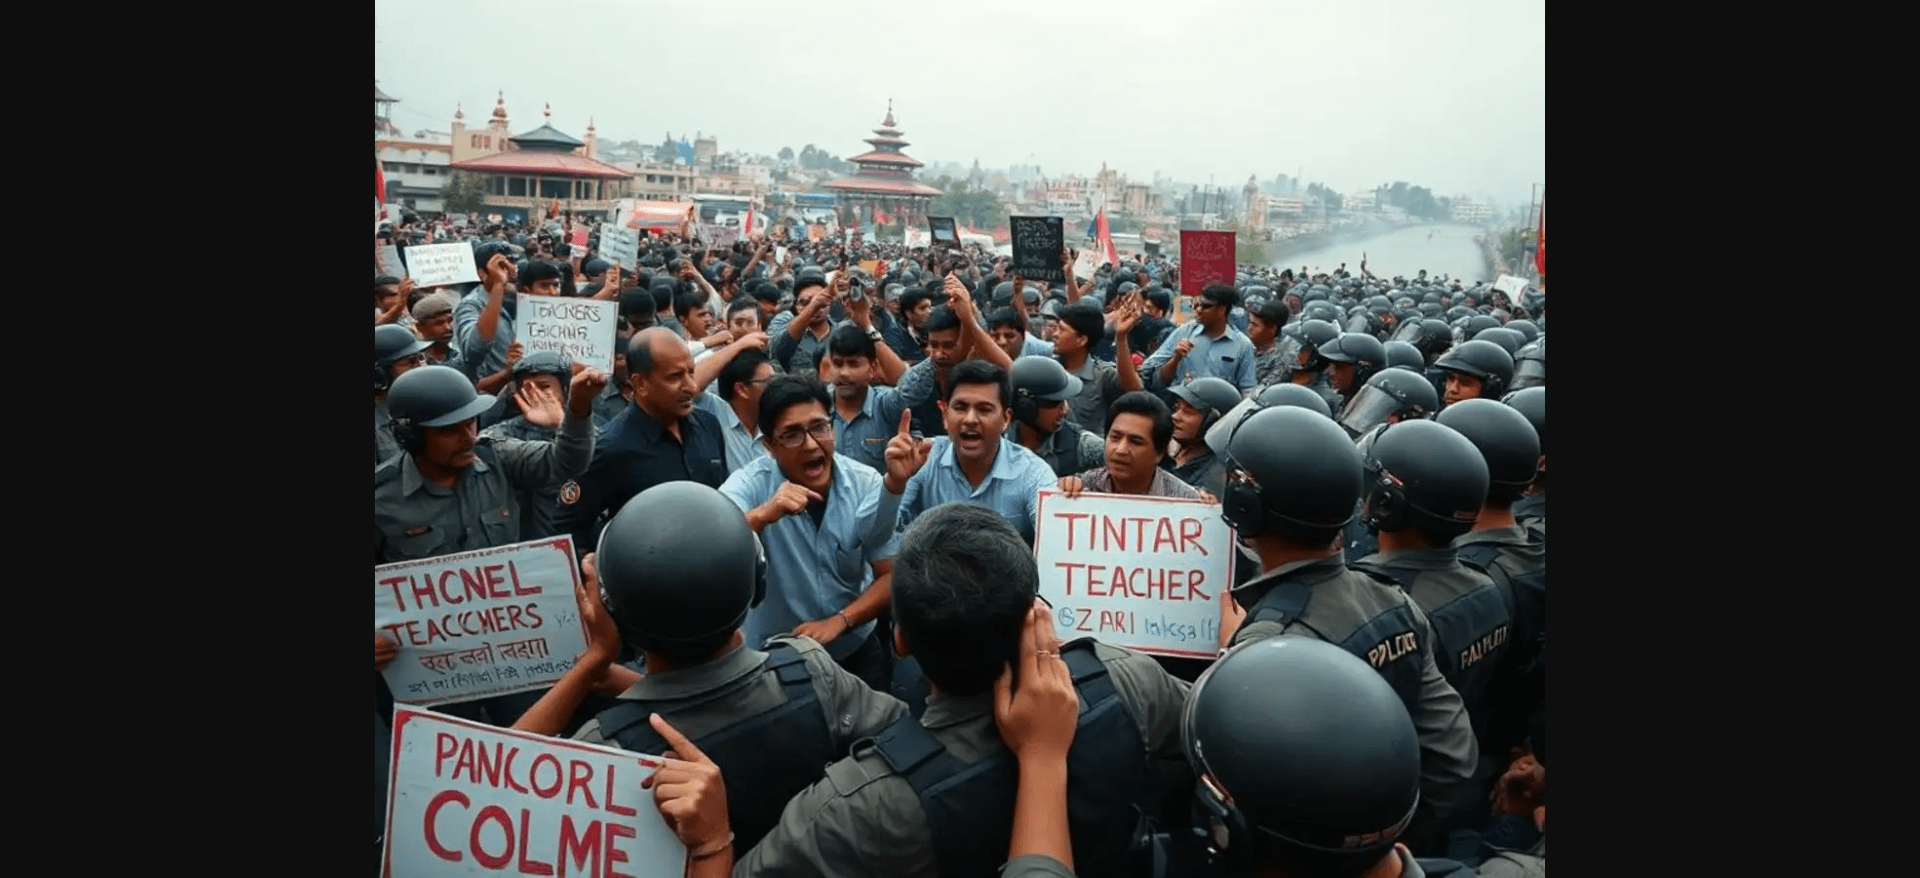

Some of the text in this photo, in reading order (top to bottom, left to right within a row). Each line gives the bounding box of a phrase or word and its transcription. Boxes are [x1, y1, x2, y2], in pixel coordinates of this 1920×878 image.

[1053, 512, 1209, 556] TINTAR
[379, 560, 543, 612] THCNEL
[1055, 562, 1211, 601] TEACHER
[423, 789, 637, 878] COLME
